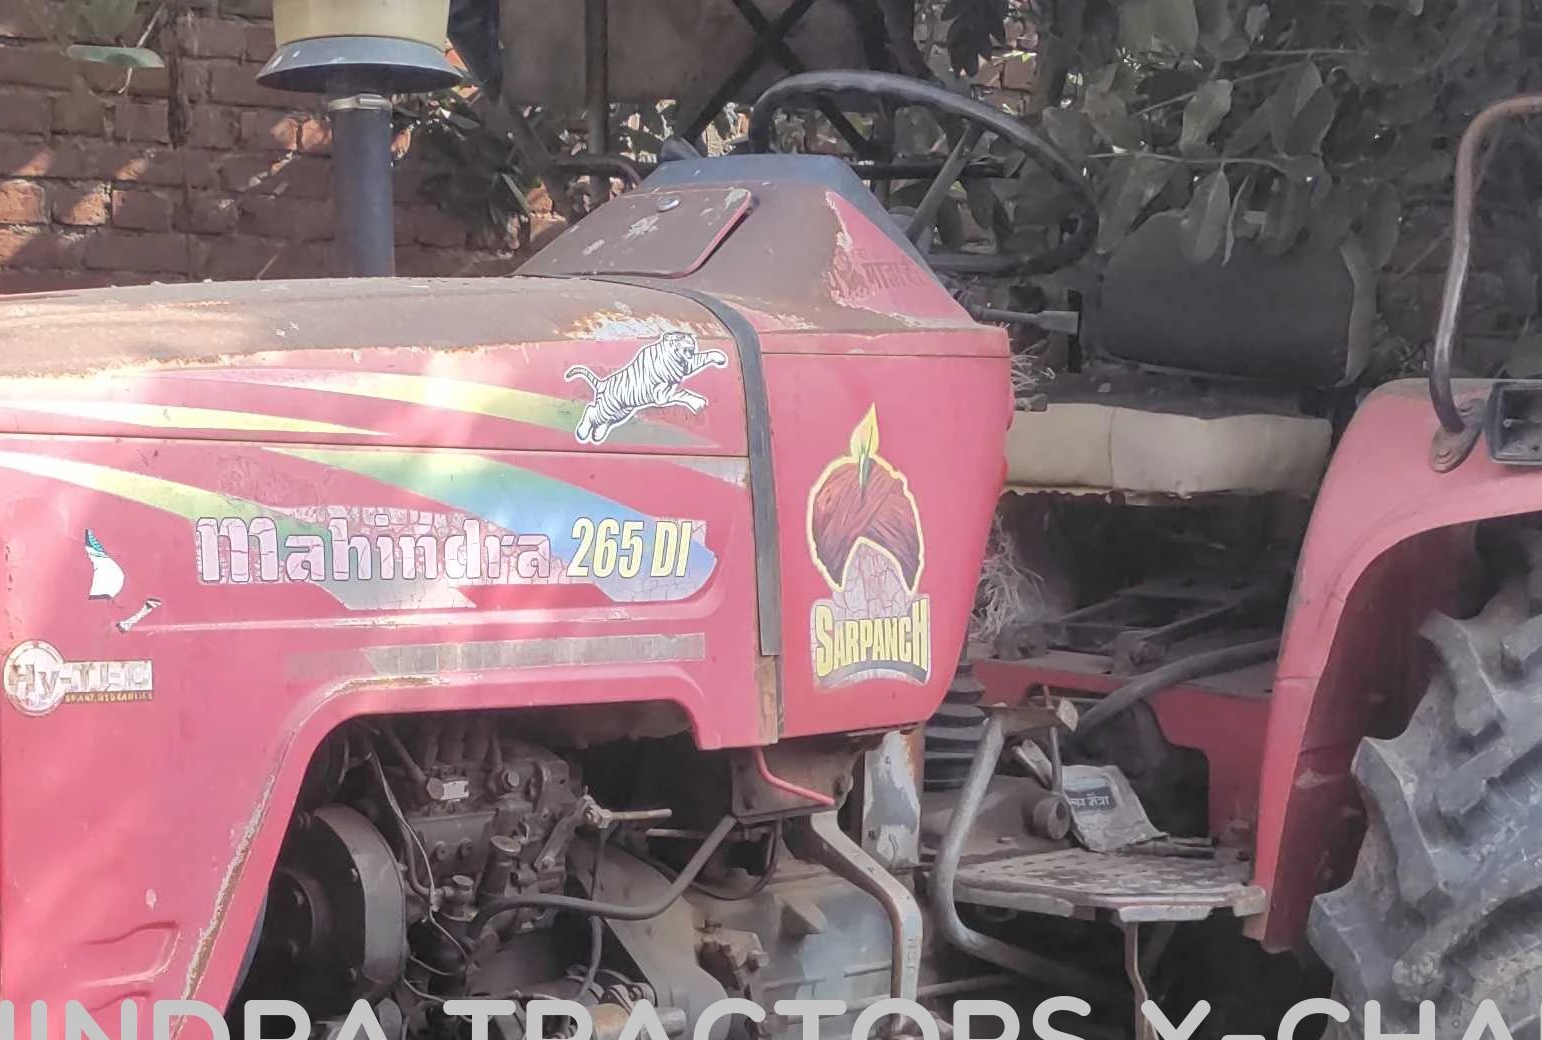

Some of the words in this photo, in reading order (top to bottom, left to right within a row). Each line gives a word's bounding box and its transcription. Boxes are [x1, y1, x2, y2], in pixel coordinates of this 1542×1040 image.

[196, 516, 552, 583] Mahindra
[567, 517, 645, 579] 265
[650, 520, 692, 578] DI
[814, 598, 930, 679] SARPANCH
